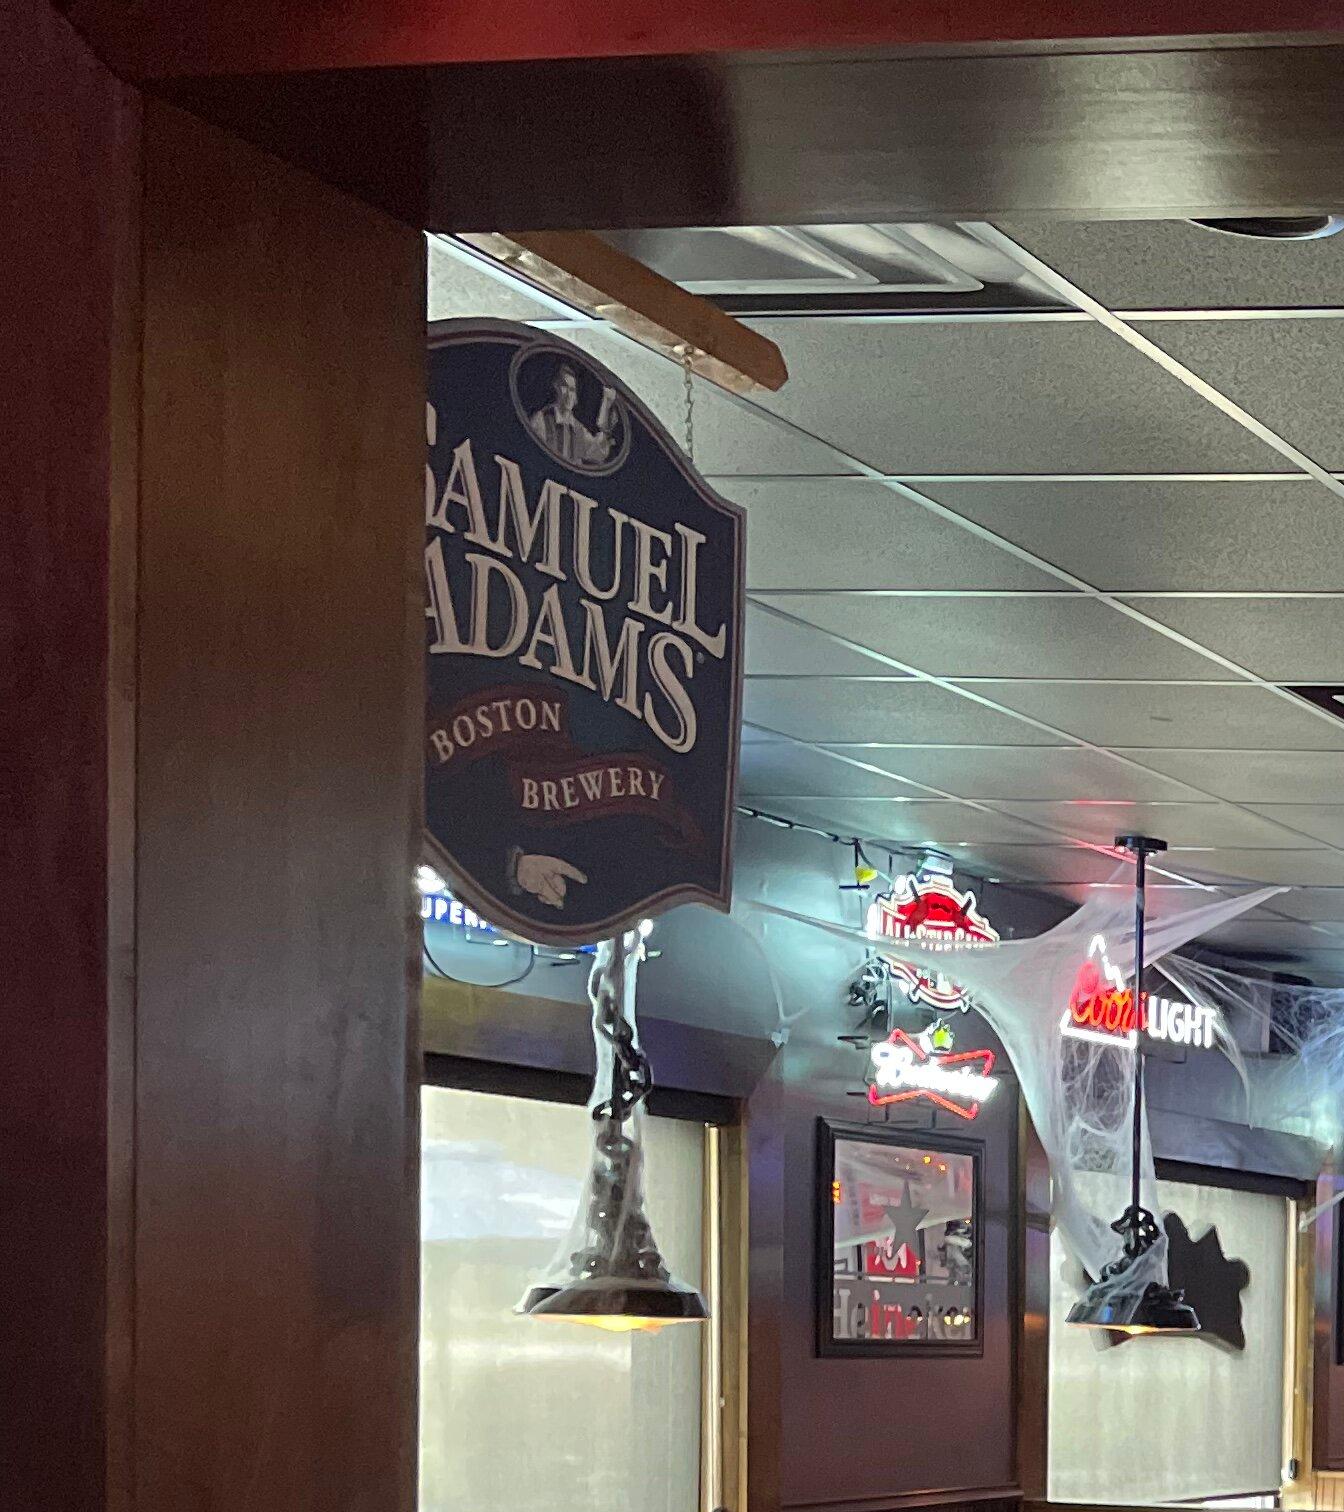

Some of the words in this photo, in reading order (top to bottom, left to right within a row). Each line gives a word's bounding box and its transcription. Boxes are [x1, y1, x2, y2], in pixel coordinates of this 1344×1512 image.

[425, 536, 697, 753] ADAMS
[430, 698, 562, 763] BOSTON
[521, 762, 665, 811] BREWERY
[1147, 994, 1217, 1050] LIGHT
